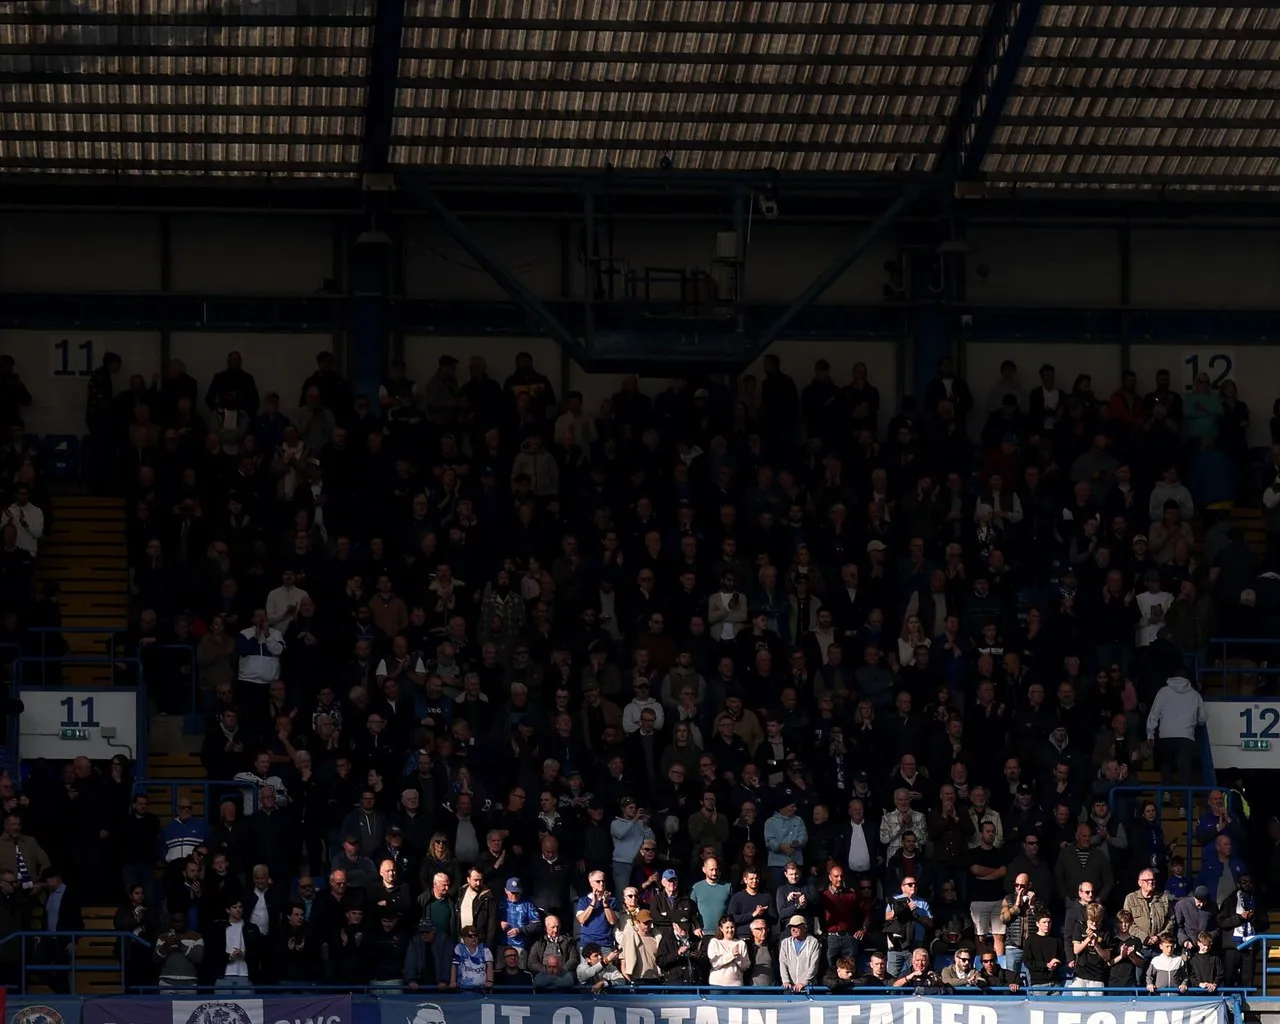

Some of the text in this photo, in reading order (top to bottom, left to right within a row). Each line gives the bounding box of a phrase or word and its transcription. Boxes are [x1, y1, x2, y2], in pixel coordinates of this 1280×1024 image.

[55, 340, 97, 375] 11
[1185, 354, 1232, 390] 12
[61, 696, 100, 728] 11
[1239, 707, 1280, 739] 12
